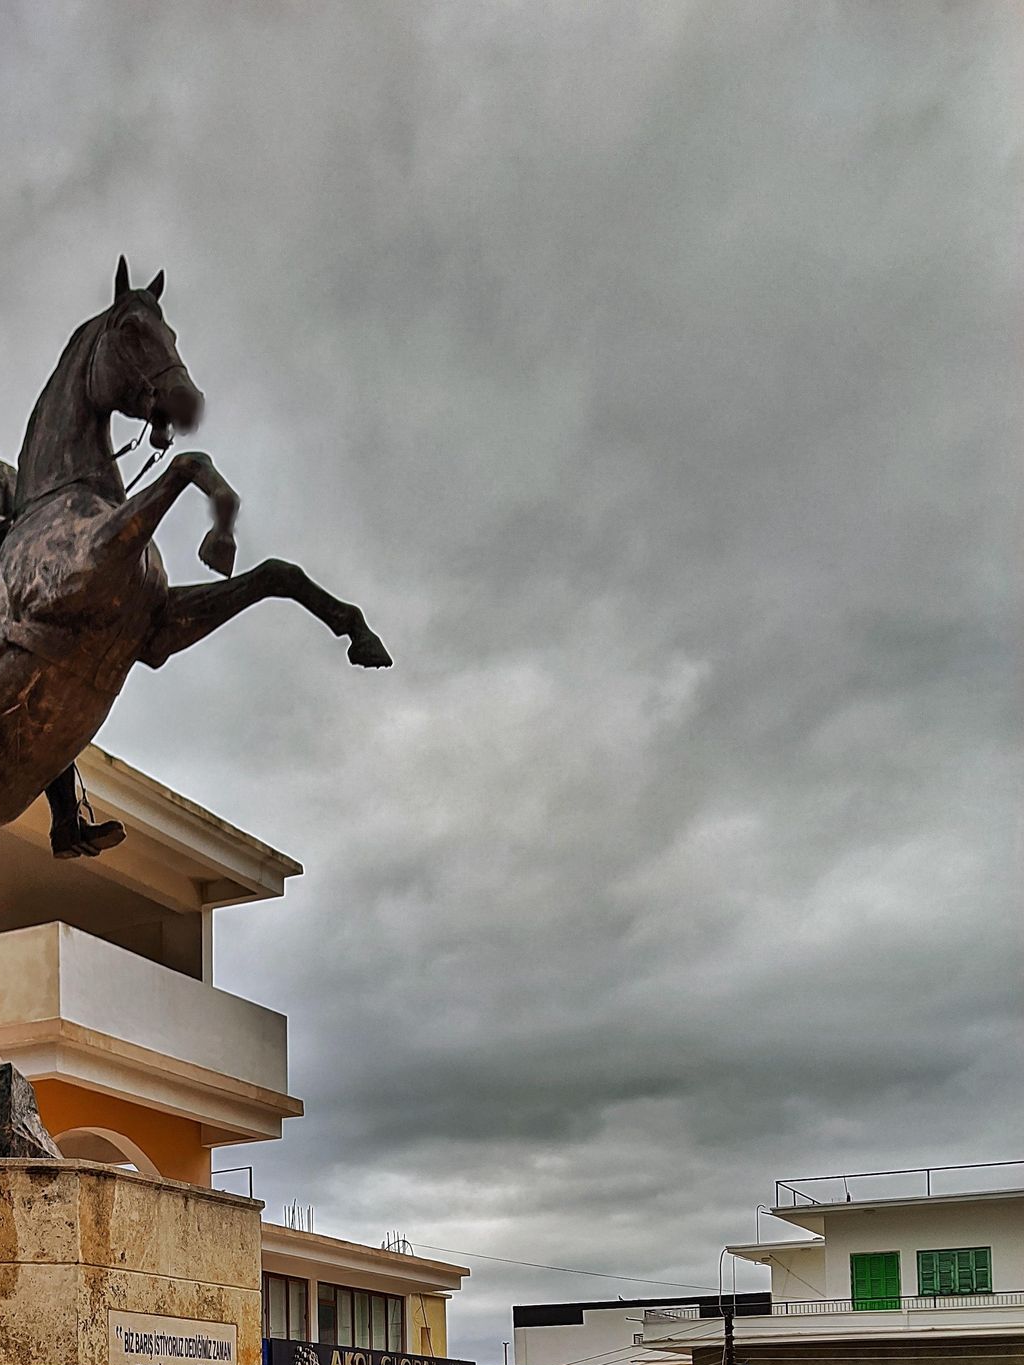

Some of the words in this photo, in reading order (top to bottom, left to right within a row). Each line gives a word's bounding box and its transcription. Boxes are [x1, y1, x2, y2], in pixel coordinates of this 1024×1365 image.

[136, 1333, 154, 1360] BARIŞ
[154, 1330, 184, 1357] İSTİYORUZ
[213, 1340, 231, 1361] ZAMAN
